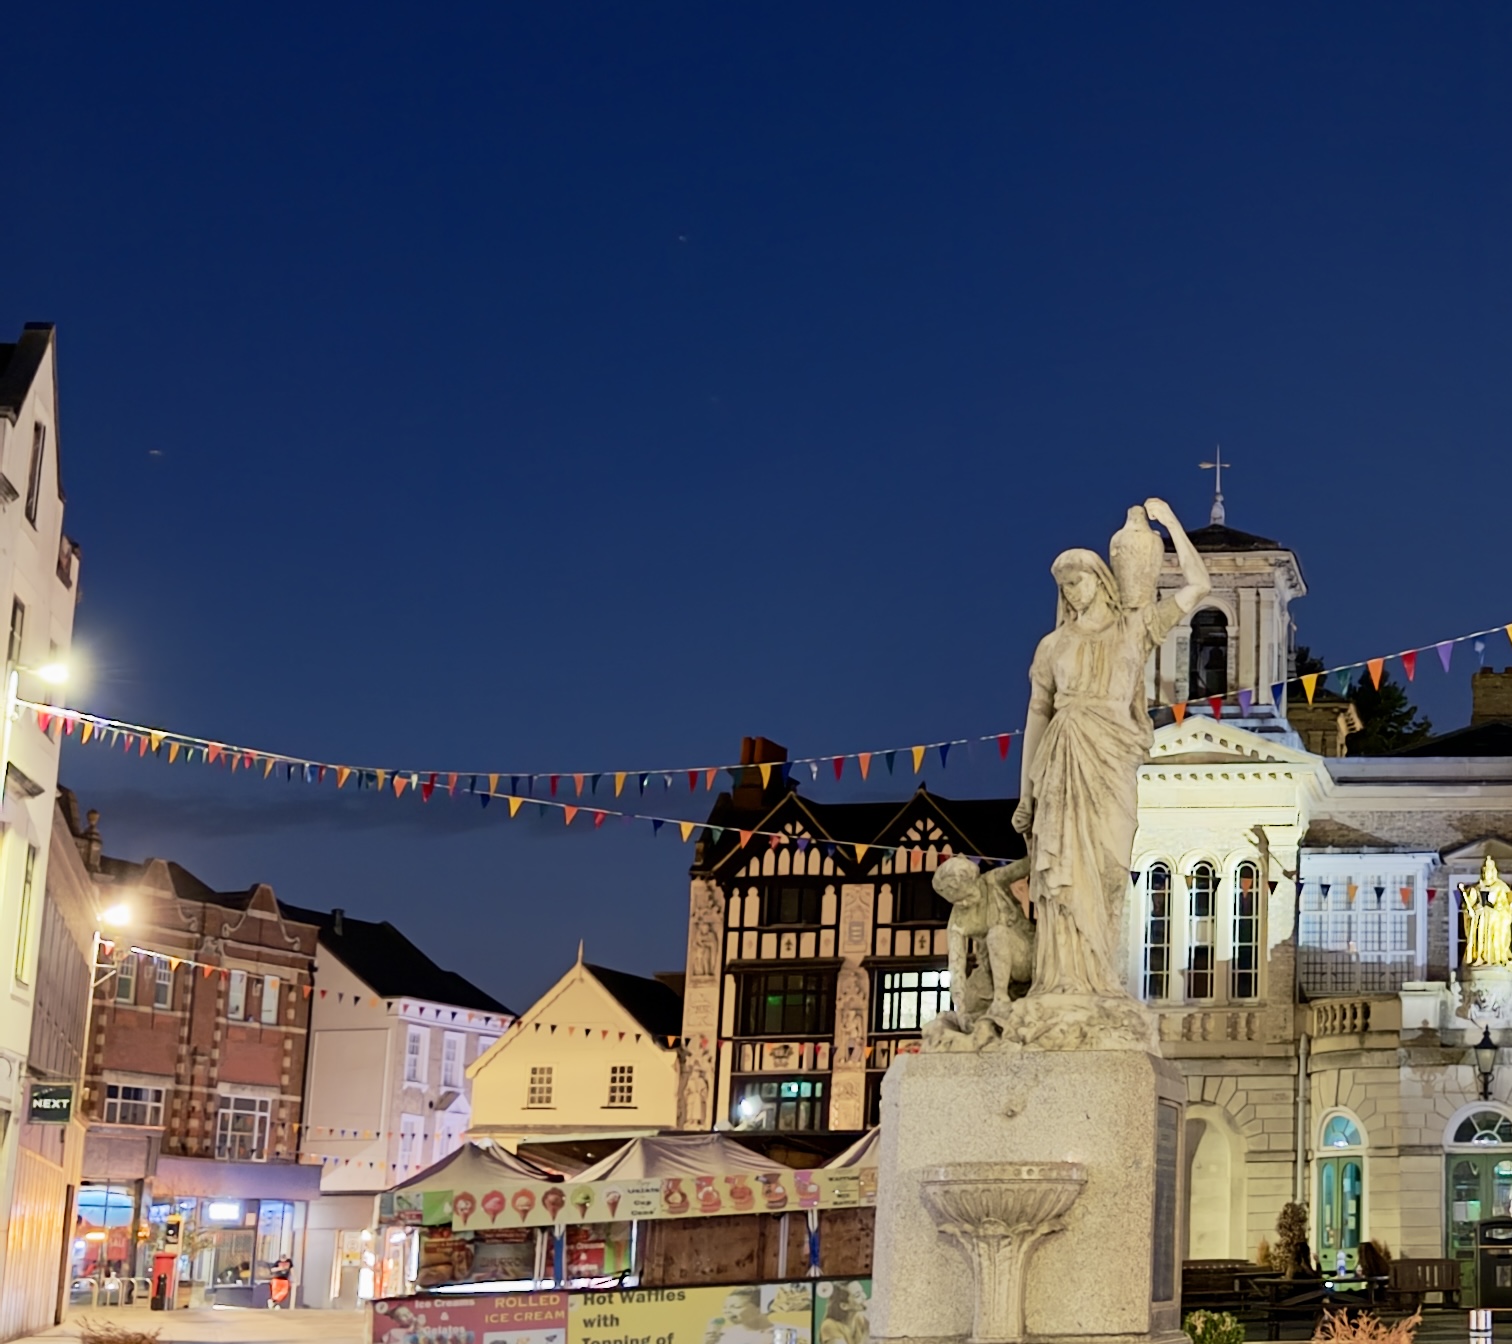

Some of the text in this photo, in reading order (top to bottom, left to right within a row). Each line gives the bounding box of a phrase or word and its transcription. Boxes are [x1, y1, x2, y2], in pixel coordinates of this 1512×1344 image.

[33, 1099, 70, 1109] NEXT
[414, 1298, 476, 1309] Ice Creams
[494, 1294, 561, 1309] ROLLED
[583, 1289, 686, 1306] Hot Waffles
[440, 1311, 450, 1321] &
[484, 1310, 566, 1324] ICE CREAM
[583, 1314, 620, 1328] with
[422, 1324, 466, 1335] Gelatos
